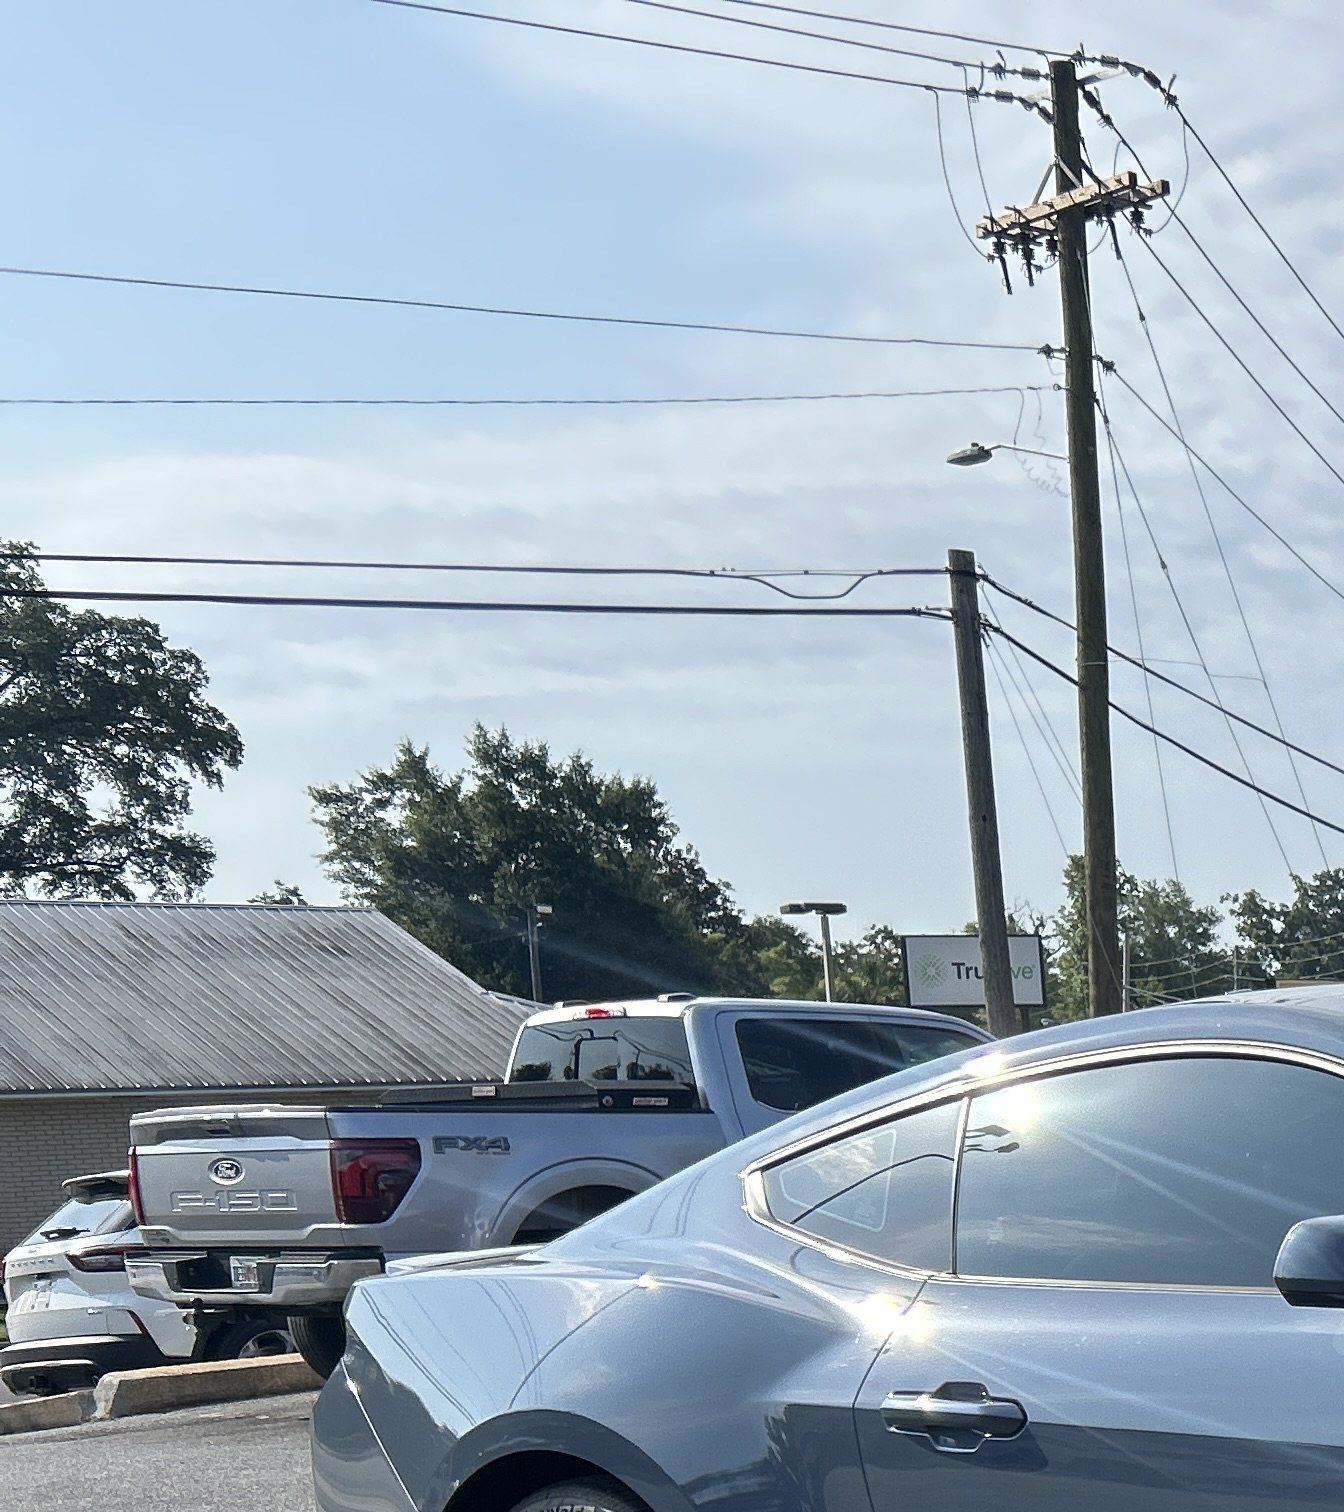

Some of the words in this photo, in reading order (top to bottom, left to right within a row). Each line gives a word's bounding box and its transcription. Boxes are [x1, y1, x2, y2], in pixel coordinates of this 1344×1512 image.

[951, 962, 1034, 980] Truve
[433, 1135, 511, 1154] FX4
[170, 1189, 298, 1213] F-150
